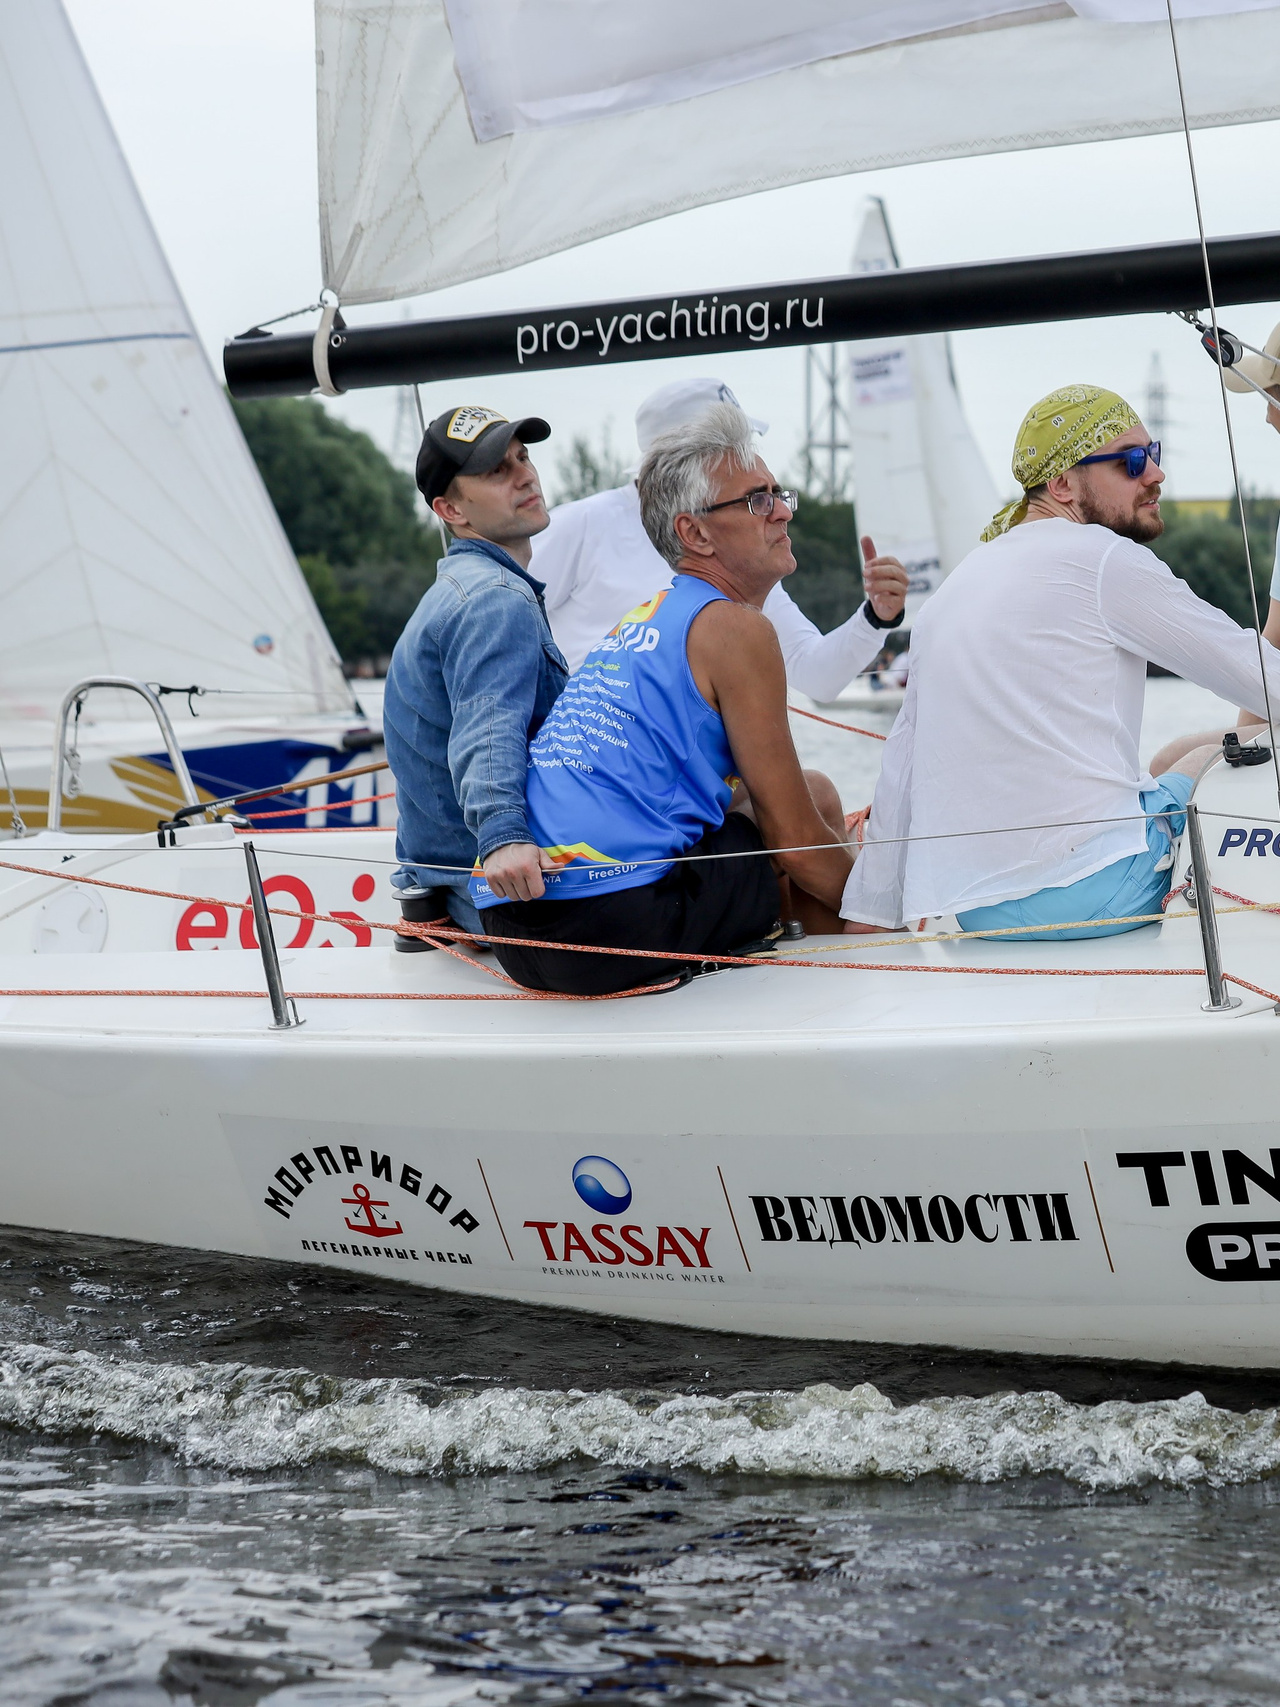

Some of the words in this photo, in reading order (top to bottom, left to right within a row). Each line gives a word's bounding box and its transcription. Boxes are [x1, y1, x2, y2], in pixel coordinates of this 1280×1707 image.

[516, 295, 825, 365] pro-yachting.ru
[588, 863, 638, 881] FreeSUP
[264, 1144, 481, 1234] МОРПРИБОР
[522, 1220, 714, 1269] TASSAY
[748, 1192, 1081, 1250] ВЕДОМОСТИ
[301, 1239, 420, 1261] ЛЕГЕНДАРНЫЕ
[424, 1249, 474, 1266] ЧАСЫ
[541, 1266, 602, 1279] PREMIUM
[607, 1270, 676, 1283] DRINKING
[681, 1273, 726, 1284] WATER
